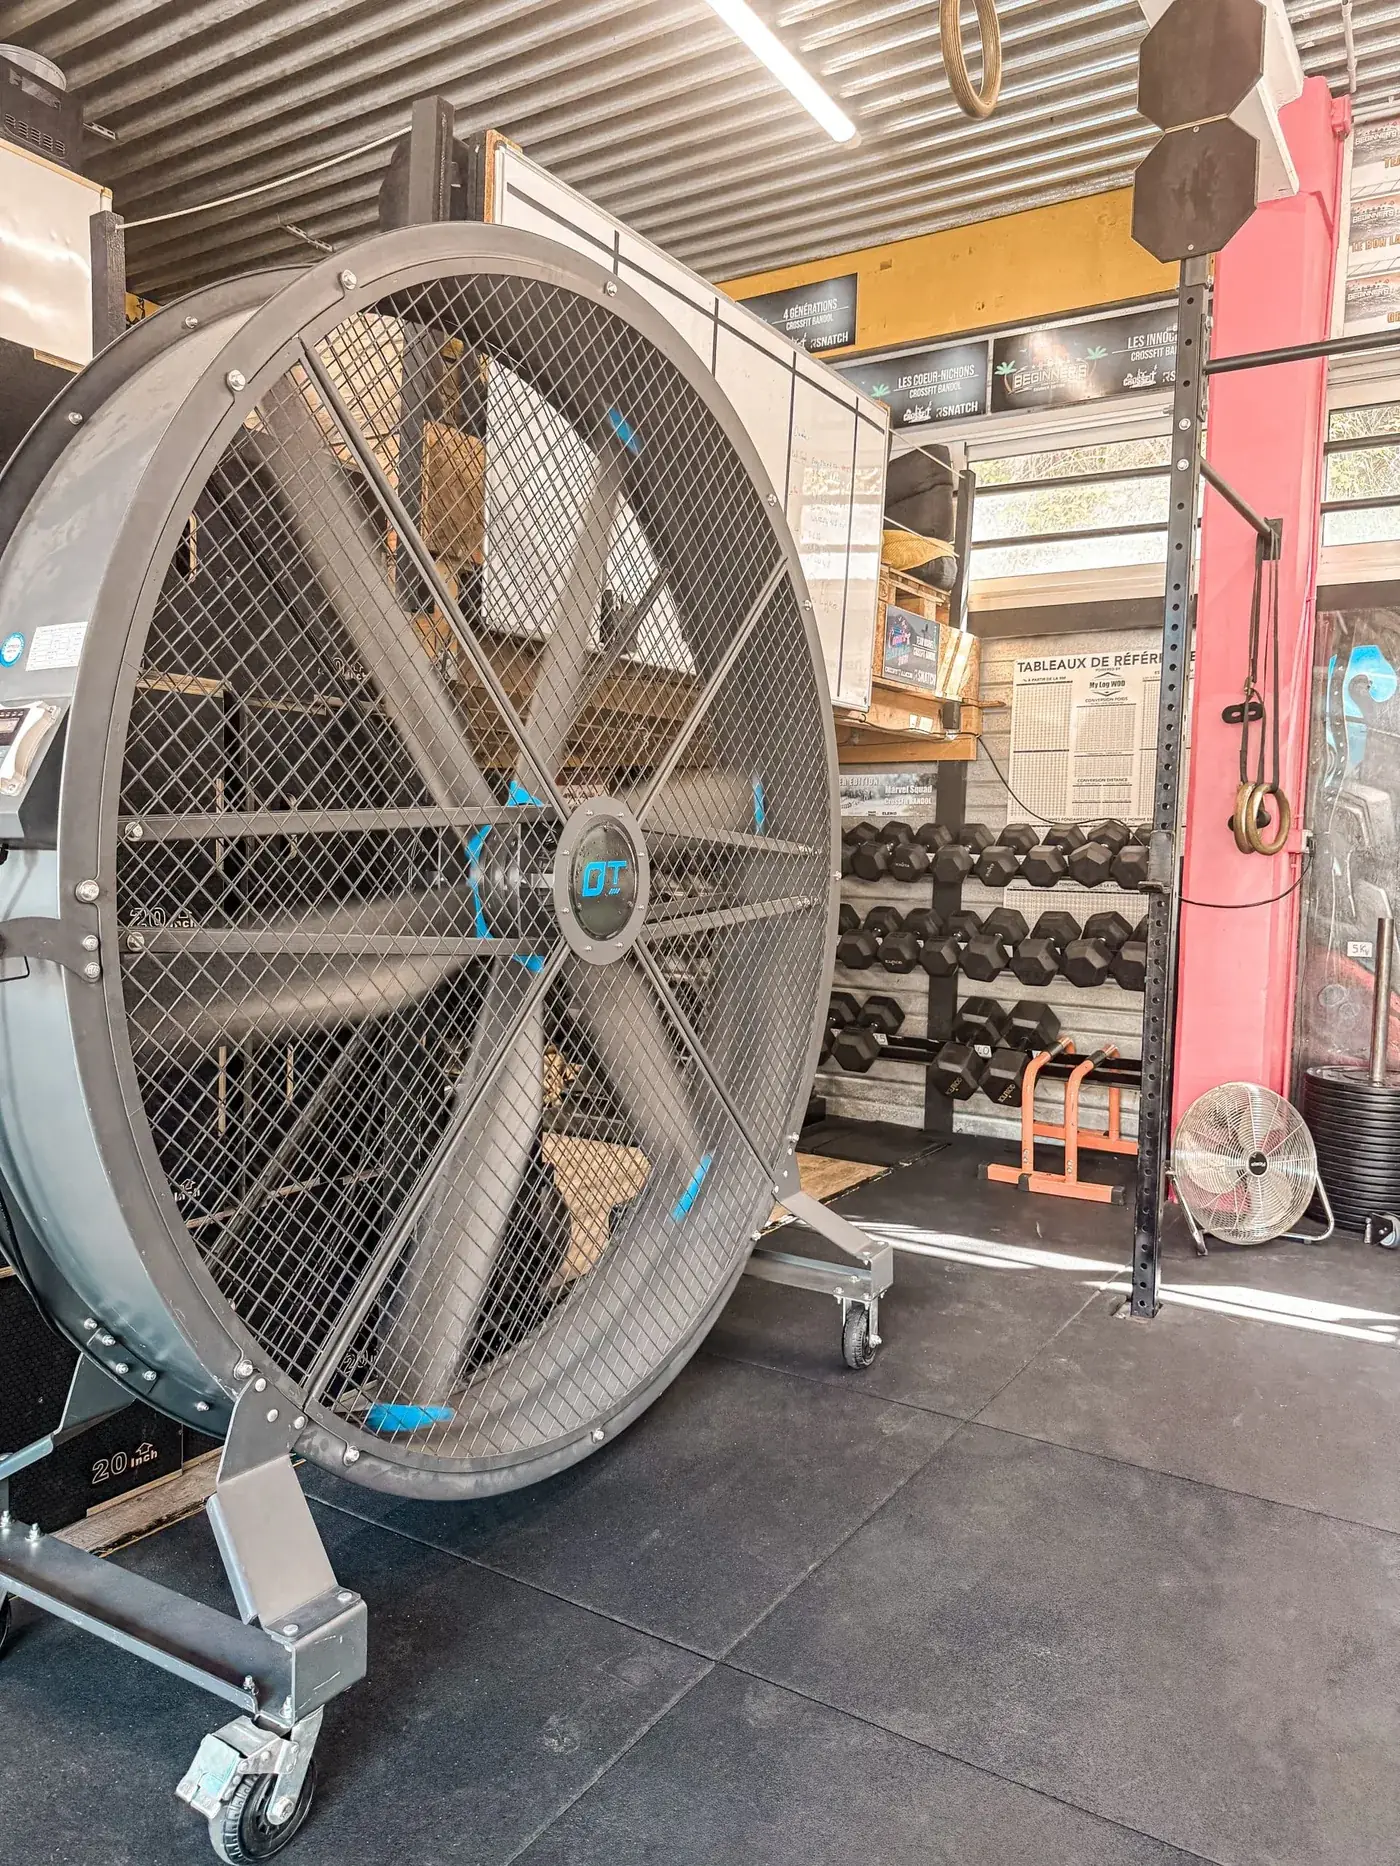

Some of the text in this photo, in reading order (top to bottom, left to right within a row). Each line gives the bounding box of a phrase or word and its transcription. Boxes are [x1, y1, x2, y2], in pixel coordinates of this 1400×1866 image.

[782, 298, 838, 321] 4 GÉNÉRATIONS
[786, 313, 834, 331] CROSSFIT BANDOL
[1127, 331, 1178, 349] LES INNOC
[1130, 347, 1165, 362] CROSSFIT
[898, 364, 975, 389] LES COEUR-NICHONS
[909, 381, 963, 399] CROSSFIT BANDOL
[1018, 657, 1087, 673] TABLEAUX
[1091, 656, 1110, 669] DE
[1089, 680, 1126, 689] My Log WOD
[885, 785, 933, 796] Marvel Squad
[92, 1449, 158, 1485] 20 Inch
